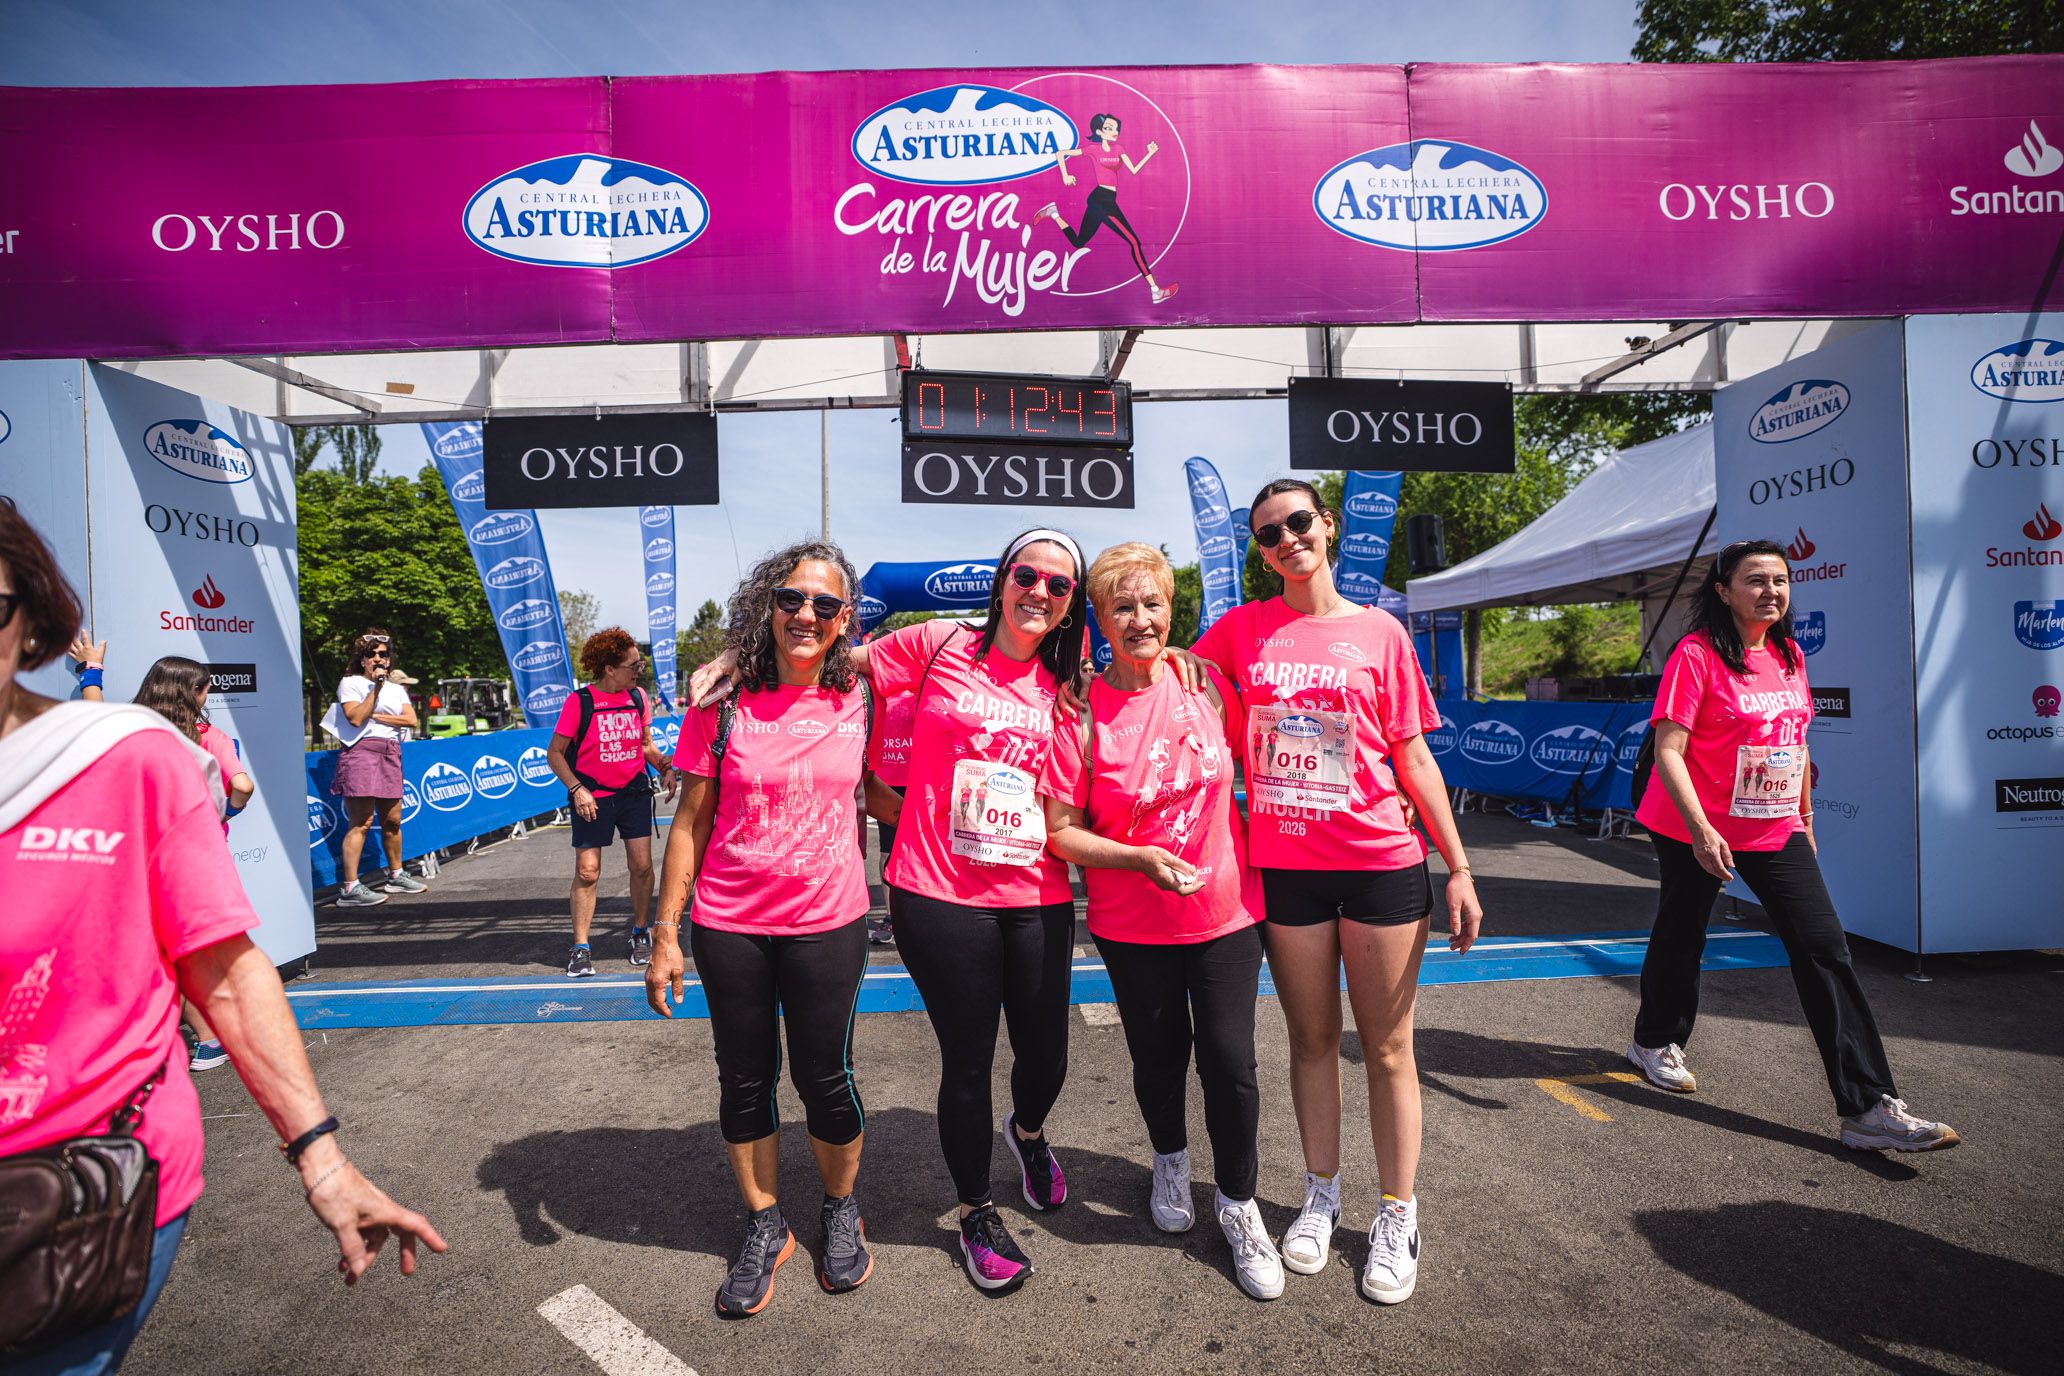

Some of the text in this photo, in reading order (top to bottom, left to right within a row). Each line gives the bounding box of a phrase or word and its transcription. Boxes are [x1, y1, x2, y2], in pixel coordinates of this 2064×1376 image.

[903, 116, 1054, 131] CENTRAL LECHERA
[870, 124, 1060, 163] ASTURIANA
[1367, 176, 1521, 188] CENTRAL LECHERA
[520, 192, 600, 205] CENTRAL
[833, 183, 1021, 236] Carrera
[1332, 179, 1530, 222] ASTURIANA
[1659, 181, 1835, 221] OYSHO
[1950, 185, 2064, 215] Santan
[482, 196, 690, 239] ASTURIANA
[152, 209, 345, 252] OYSHO
[880, 225, 1092, 317] de la Mujer
[1981, 363, 2064, 388] ASTURI
[919, 382, 1117, 436] 01:12:43
[1755, 396, 1843, 437] ASTURIANA
[1326, 409, 1483, 446] OYSHO
[170, 433, 208, 449] CENTRAL
[152, 431, 249, 476] ASTURIANA
[520, 443, 684, 481] OYSHO
[913, 452, 1124, 501] OYSHO
[1749, 458, 1855, 506] OYSHO
[1349, 501, 1394, 514] ASTURIANA
[144, 504, 260, 548] OYSHO
[1986, 546, 2063, 568] Santan
[1789, 562, 1847, 584] tander
[932, 577, 994, 593] ASTURIA
[1340, 582, 1379, 595] STURIANA
[160, 610, 255, 634] Santander
[2018, 611, 2064, 638] Marlen
[210, 673, 251, 690] rogena
[1251, 661, 1348, 693] CARRERA
[597, 712, 637, 732] HOY
[957, 690, 1053, 738] CARRERA
[1103, 723, 1144, 745] OYSHO
[1280, 722, 1322, 734] ASTURIANA
[1986, 726, 2054, 743] octopus
[1462, 734, 1518, 756] ASTURIANA
[1277, 752, 1319, 771] 016
[1287, 771, 1307, 780] 2018
[1763, 780, 1788, 792] 016
[425, 782, 470, 803] ASTURIANA
[2002, 785, 2064, 806] Neutro
[986, 808, 1022, 828] 016
[1813, 798, 1860, 819] energy
[995, 828, 1013, 837] 2017
[1278, 820, 1307, 836] 2026
[20, 826, 125, 854] DKV
[962, 842, 993, 856] OYSHO
[233, 845, 268, 864] nergy
